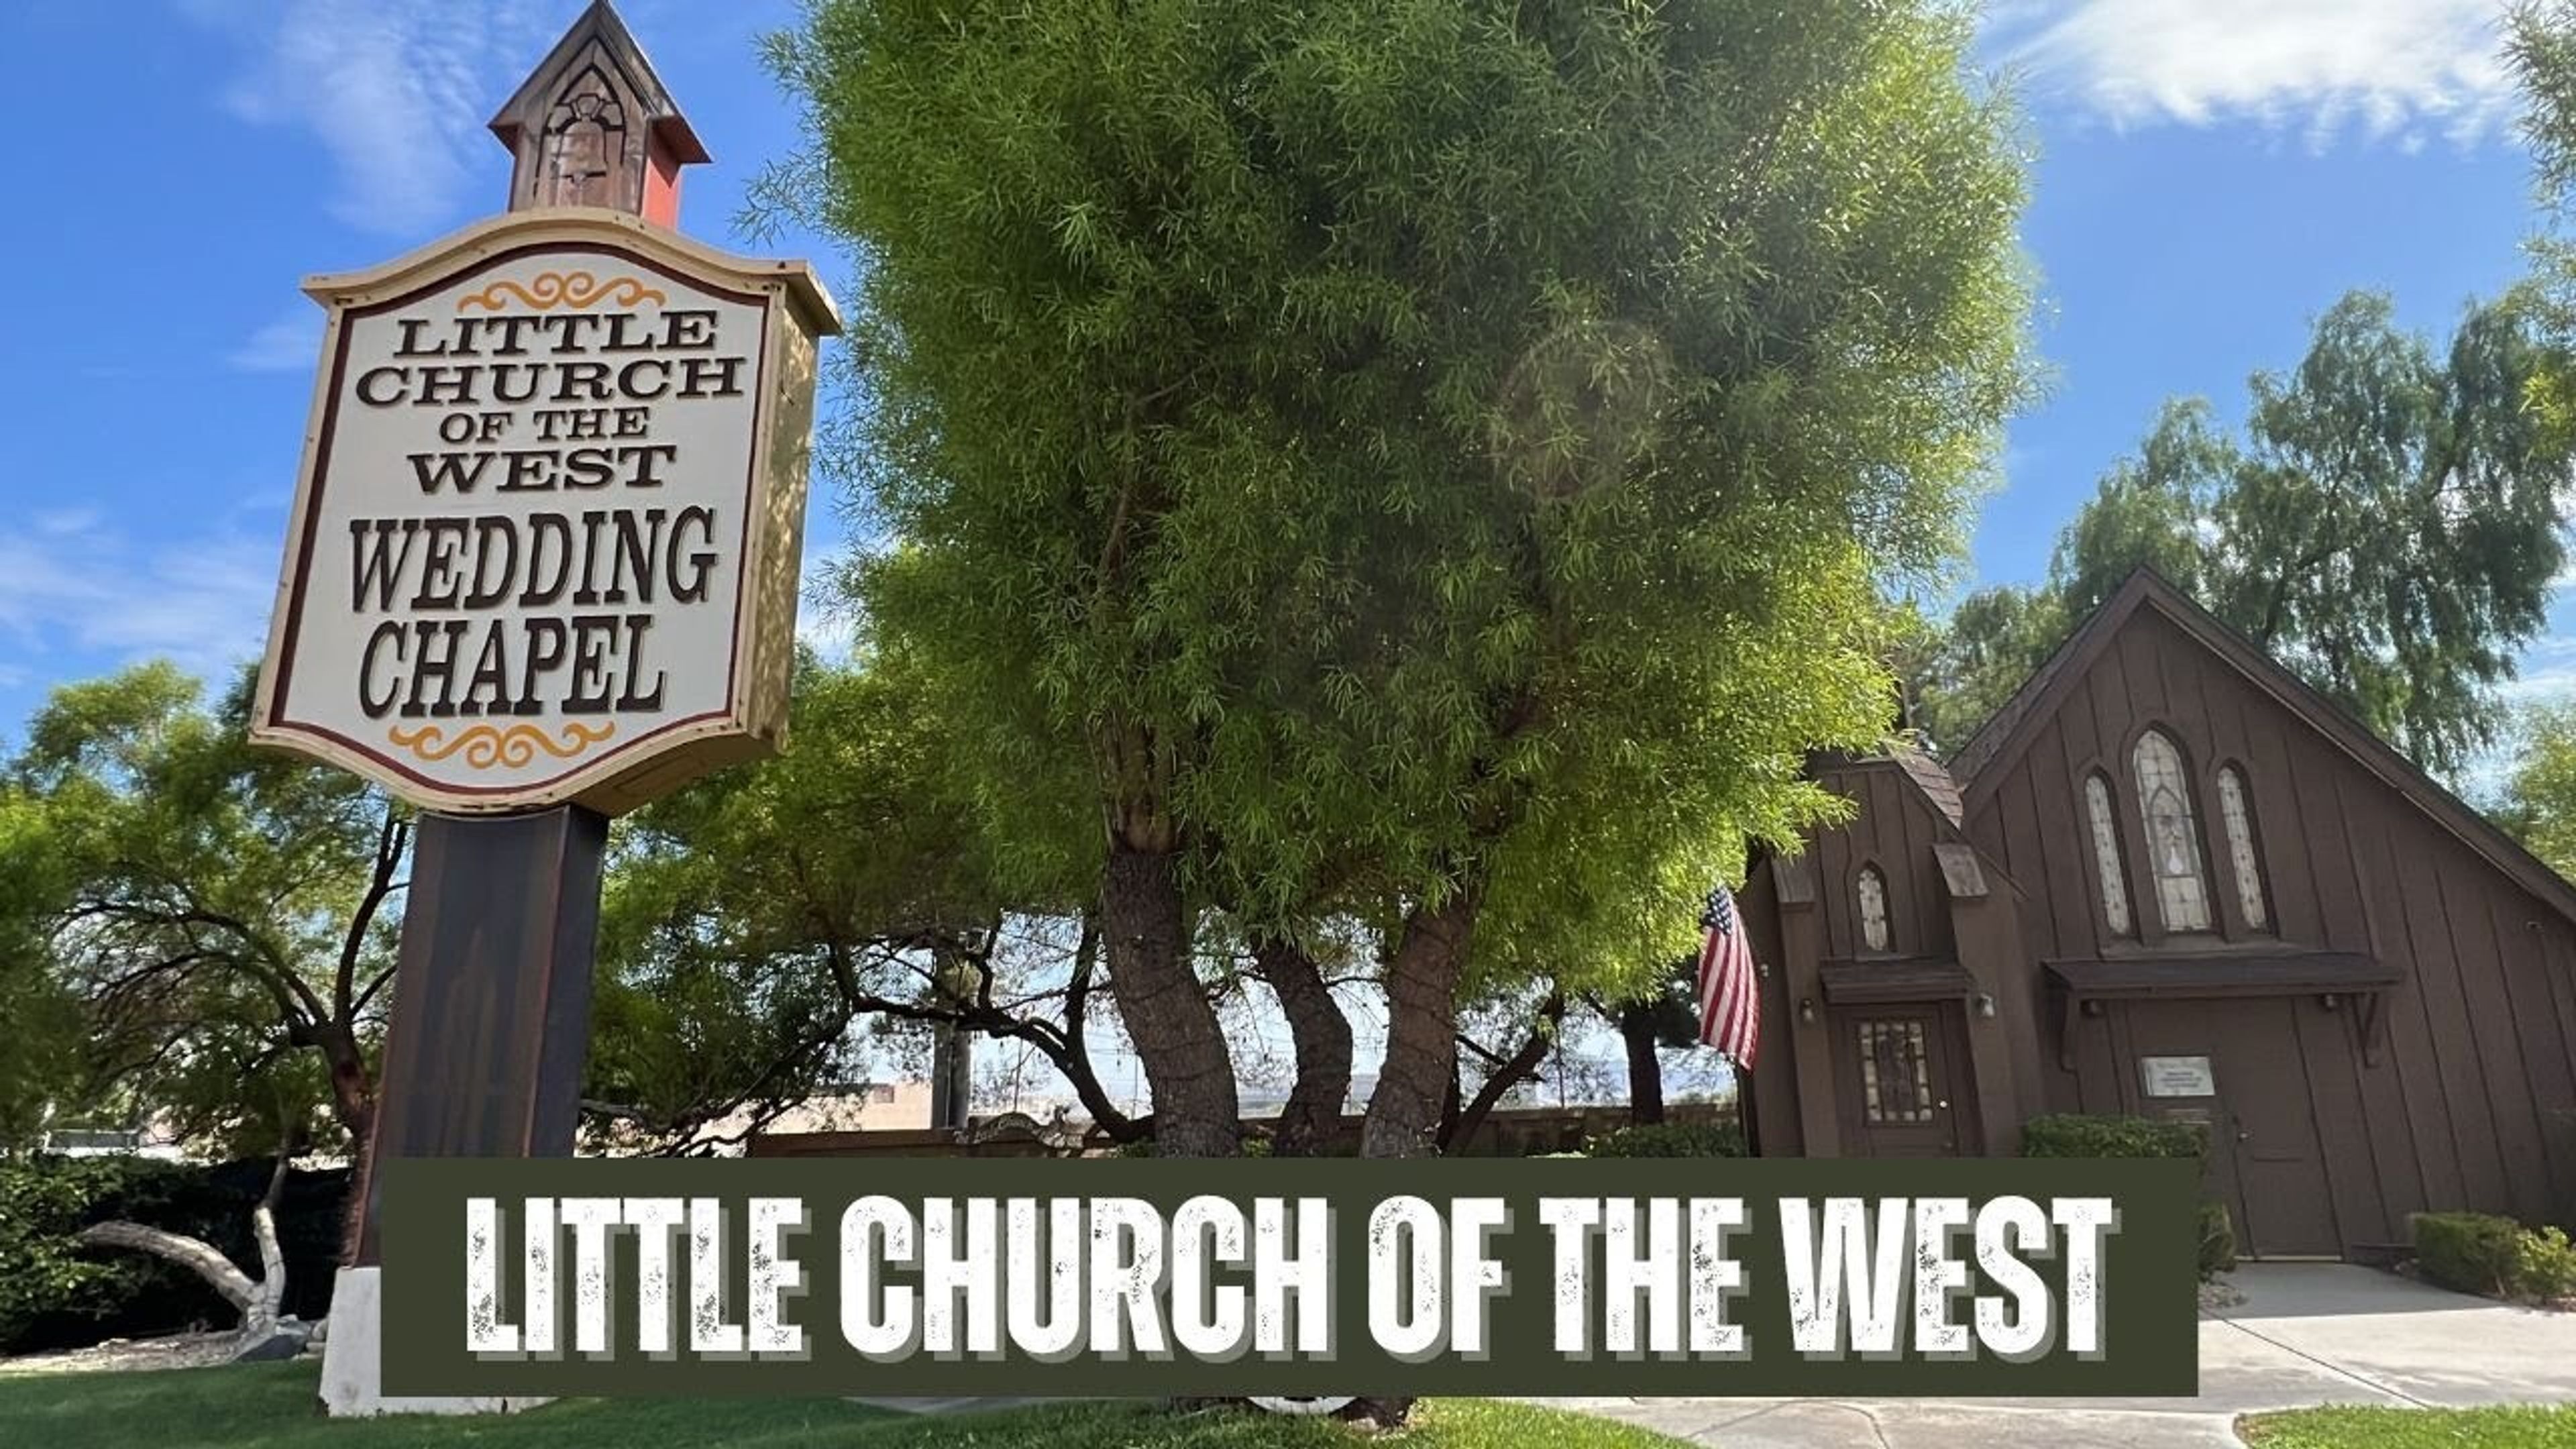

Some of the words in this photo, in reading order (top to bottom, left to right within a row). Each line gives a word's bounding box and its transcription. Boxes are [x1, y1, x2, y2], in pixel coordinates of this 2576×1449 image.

[392, 309, 718, 358] LITTLE
[356, 357, 747, 408] CHURCH
[439, 412, 513, 444] OF
[533, 407, 650, 441] THE
[407, 444, 678, 494] WEST
[349, 504, 719, 613] WEDDING
[359, 614, 665, 720] CHAPEL
